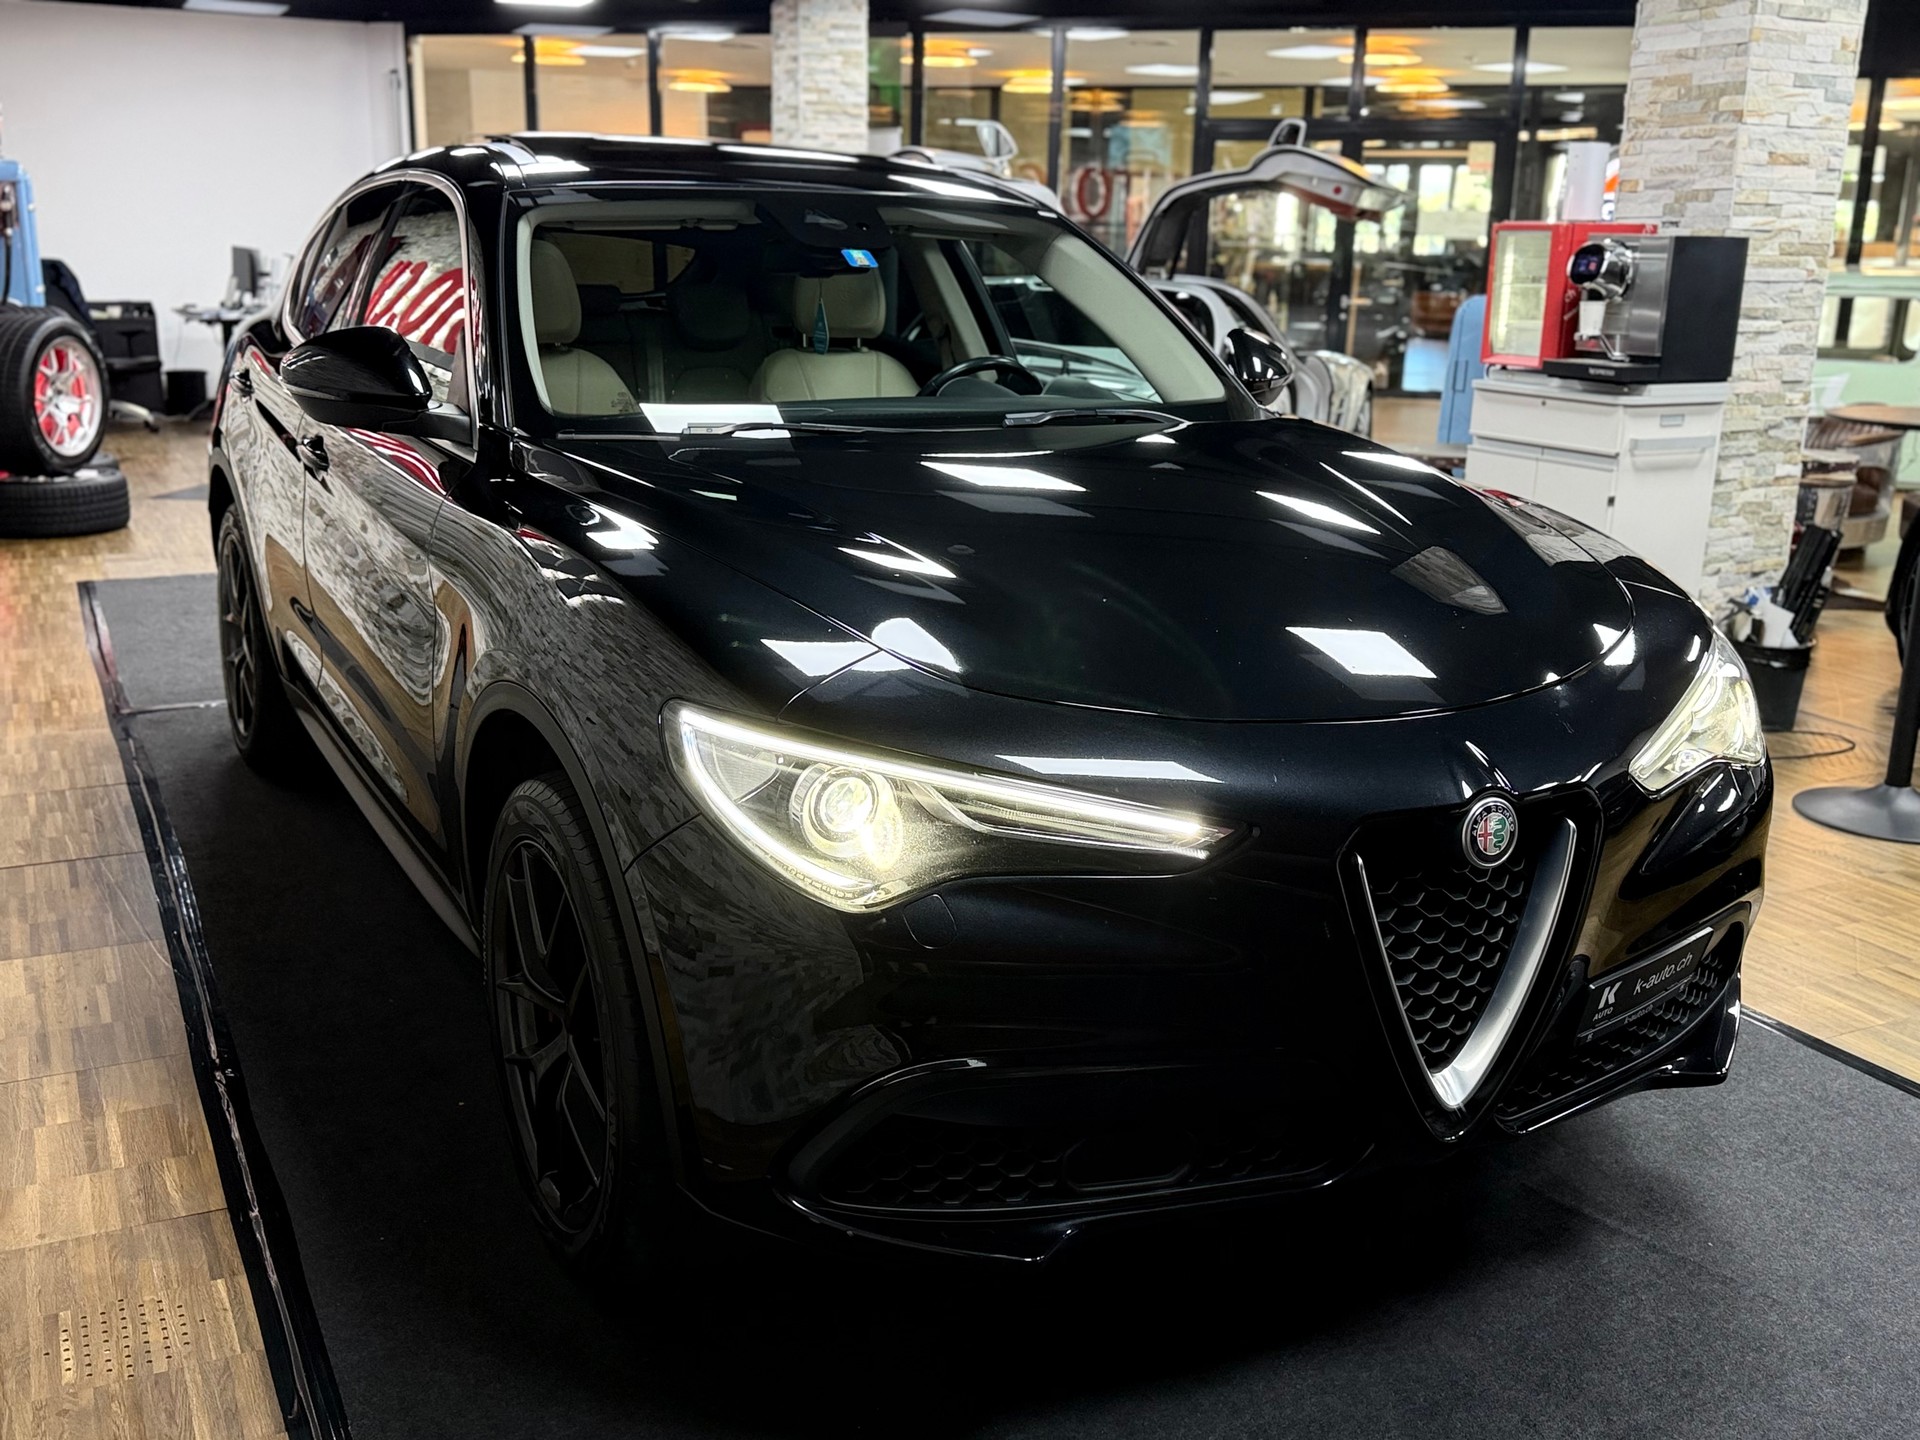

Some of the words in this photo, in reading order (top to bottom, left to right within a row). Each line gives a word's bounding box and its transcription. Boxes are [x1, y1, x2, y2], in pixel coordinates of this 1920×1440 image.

[1472, 811, 1488, 837] ALFA
[1490, 805, 1515, 832] ROMEO
[1633, 952, 1693, 995] k-auto.ch
[1598, 981, 1622, 1009] K
[1592, 1006, 1614, 1022] AUTO
